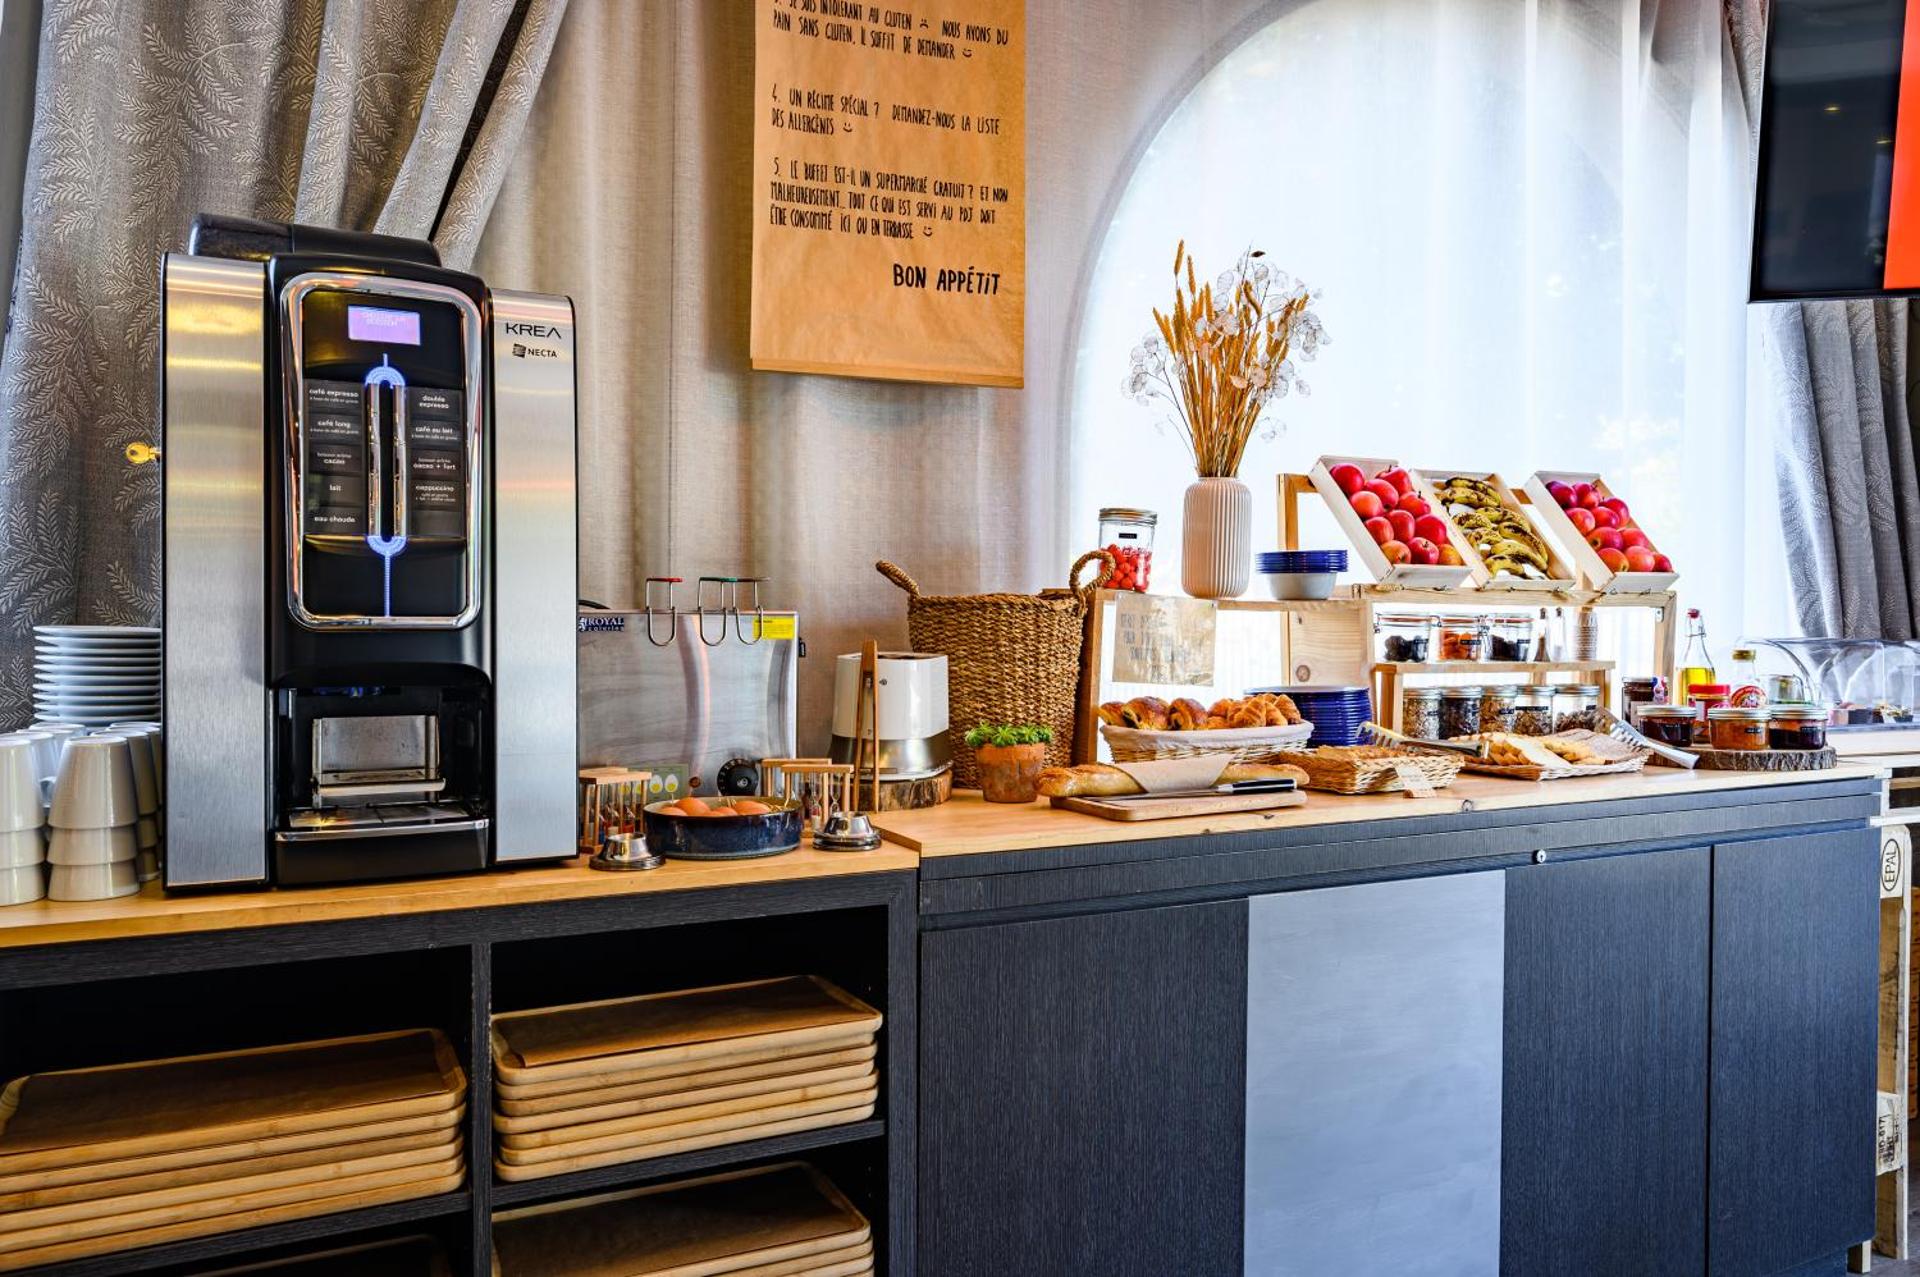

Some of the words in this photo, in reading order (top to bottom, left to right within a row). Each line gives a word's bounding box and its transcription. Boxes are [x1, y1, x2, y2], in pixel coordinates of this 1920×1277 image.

[773, 9, 791, 32] PAIN
[798, 16, 819, 38] SANS
[903, 36, 912, 54] DE
[917, 38, 956, 60] DEMANDER
[868, 7, 880, 24] AU
[942, 20, 961, 39] NOUS
[966, 24, 991, 43] AVONS
[996, 28, 1009, 45] DU
[771, 107, 784, 129] DES
[789, 88, 802, 108] UN
[840, 94, 868, 117] SPÉCIAL
[891, 104, 956, 130] DEMANDEZ-NOUS
[961, 115, 971, 132] LA
[790, 159, 798, 180] LE
[804, 162, 828, 183] BUFFET
[859, 170, 871, 188] UN
[876, 171, 928, 194] SUPERMARCHÉ
[980, 185, 989, 201] ET
[992, 187, 1009, 203] NON
[770, 203, 787, 226] ÊTRE
[790, 208, 833, 231] CONSOMMÉ
[856, 216, 868, 235] OU
[871, 218, 880, 236] EN
[883, 219, 914, 240] TERRASSE
[848, 191, 865, 210] TOUT
[870, 195, 878, 212] CE
[881, 196, 895, 213] QUI
[898, 198, 911, 217] EST
[941, 204, 953, 221] AU
[959, 206, 973, 223] PDJ
[980, 208, 996, 224] DOIT
[893, 262, 927, 289] BON
[505, 322, 562, 340] KREA
[527, 347, 558, 358] NECTA
[334, 420, 351, 430] long
[588, 617, 625, 627] ROYAL
[1884, 846, 1897, 883] EPAL
